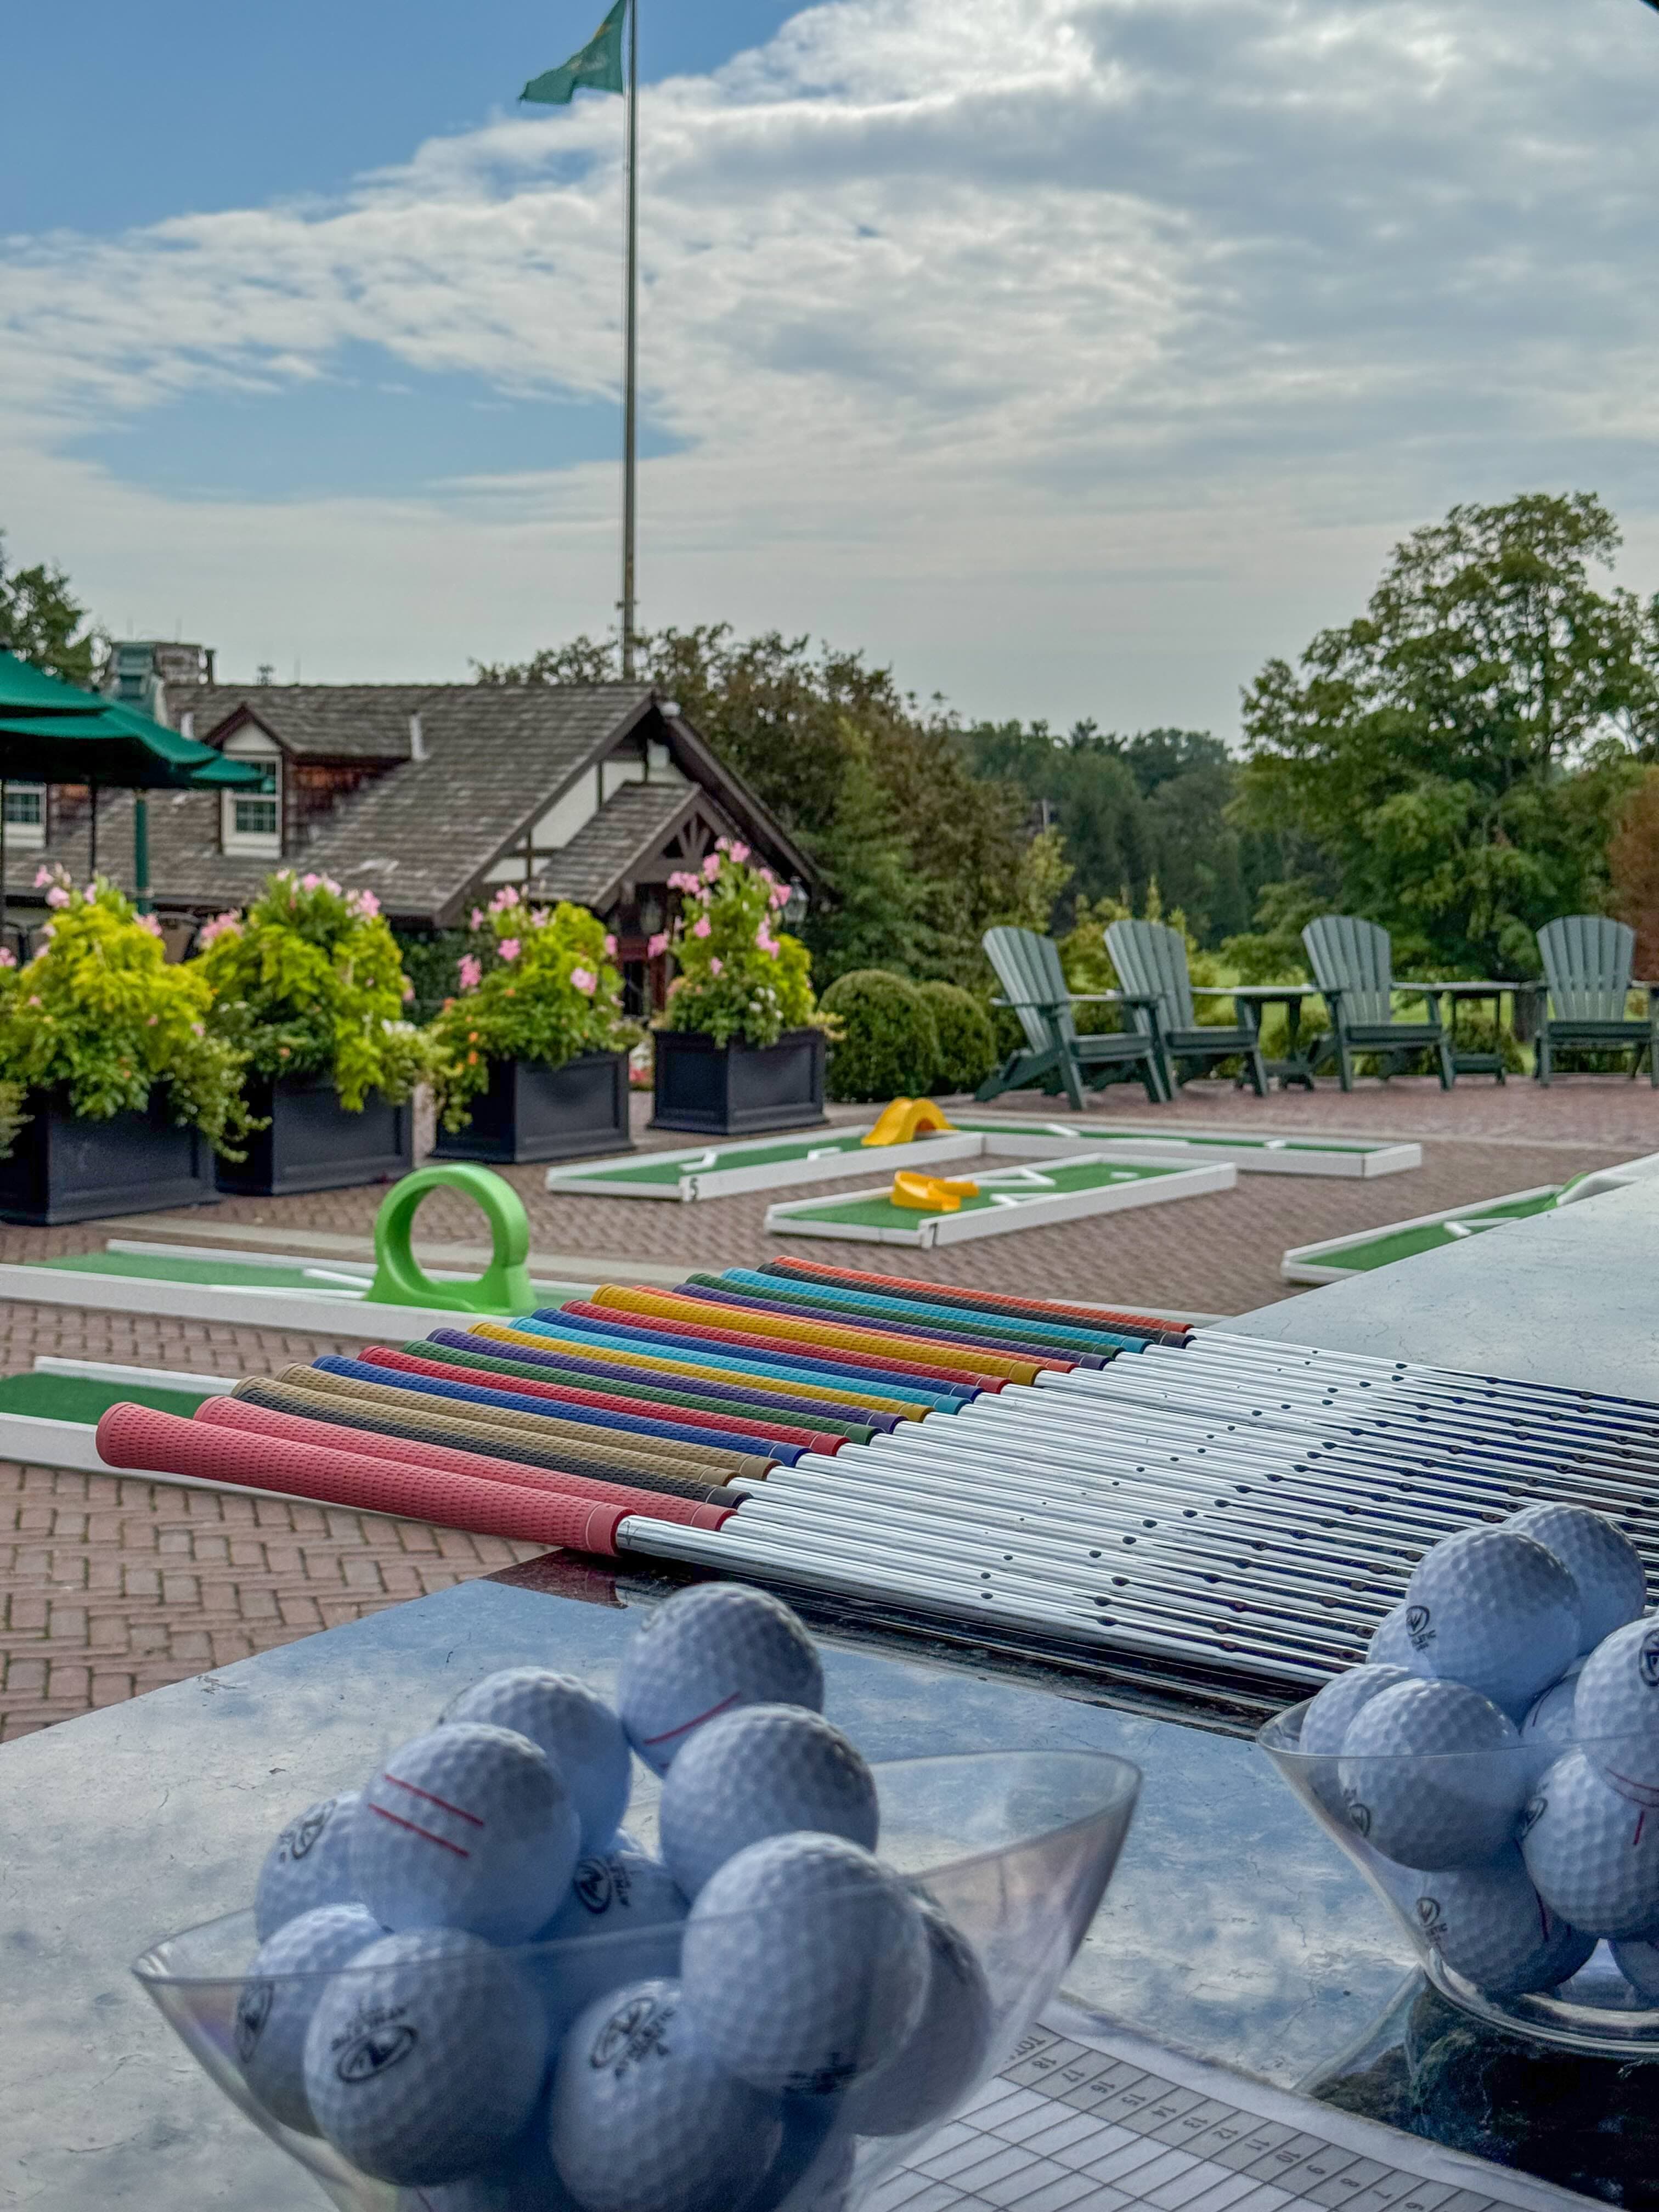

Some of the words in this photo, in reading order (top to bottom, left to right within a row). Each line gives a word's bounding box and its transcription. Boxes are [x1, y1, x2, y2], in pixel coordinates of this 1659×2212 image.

[689, 1177, 698, 1201] 5
[1032, 2057, 1057, 2068] 18
[1062, 2069, 1085, 2081] 17
[1091, 2081, 1115, 2094] 16
[1121, 2094, 1146, 2106] 15
[1152, 2106, 1177, 2117] 14
[1183, 2117, 1207, 2128] 13
[1212, 2128, 1238, 2140] 12
[1245, 2139, 1269, 2150] 11
[1275, 2150, 1301, 2163] 10
[1306, 2165, 1325, 2174] 9
[1340, 2178, 1360, 2187] 8
[1373, 2190, 1392, 2199] 7
[1405, 2202, 1424, 2210] 6
